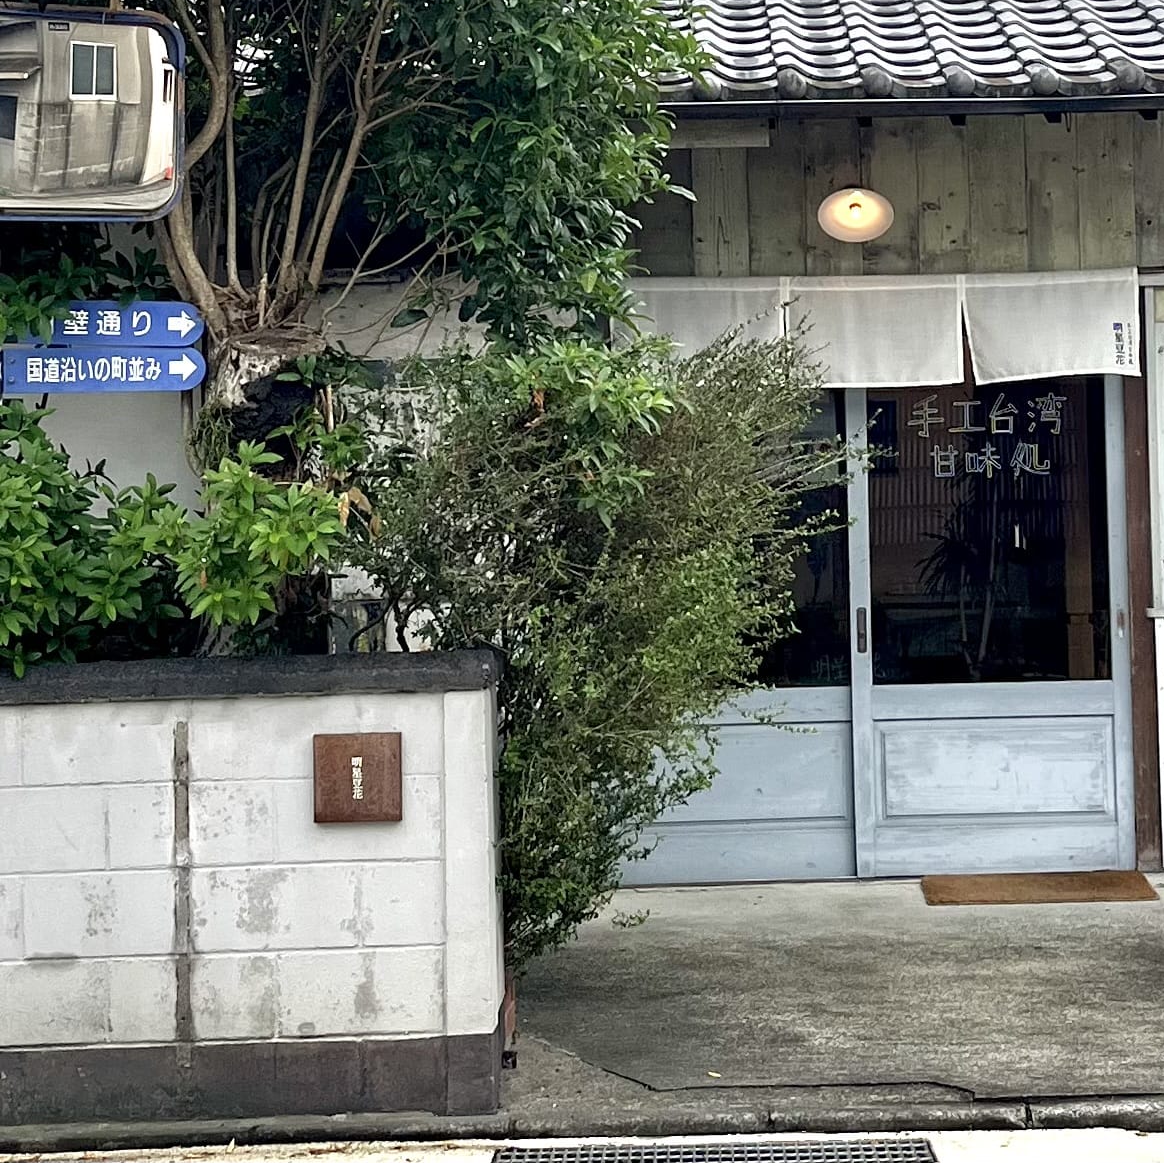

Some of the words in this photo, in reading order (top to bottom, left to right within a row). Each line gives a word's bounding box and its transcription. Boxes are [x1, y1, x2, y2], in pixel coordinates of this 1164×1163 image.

[49, 310, 152, 336] 壁通り
[26, 356, 162, 383] 国道沿いの町並み
[907, 392, 1068, 438] 手工台湾
[930, 440, 1050, 478] 甘味処
